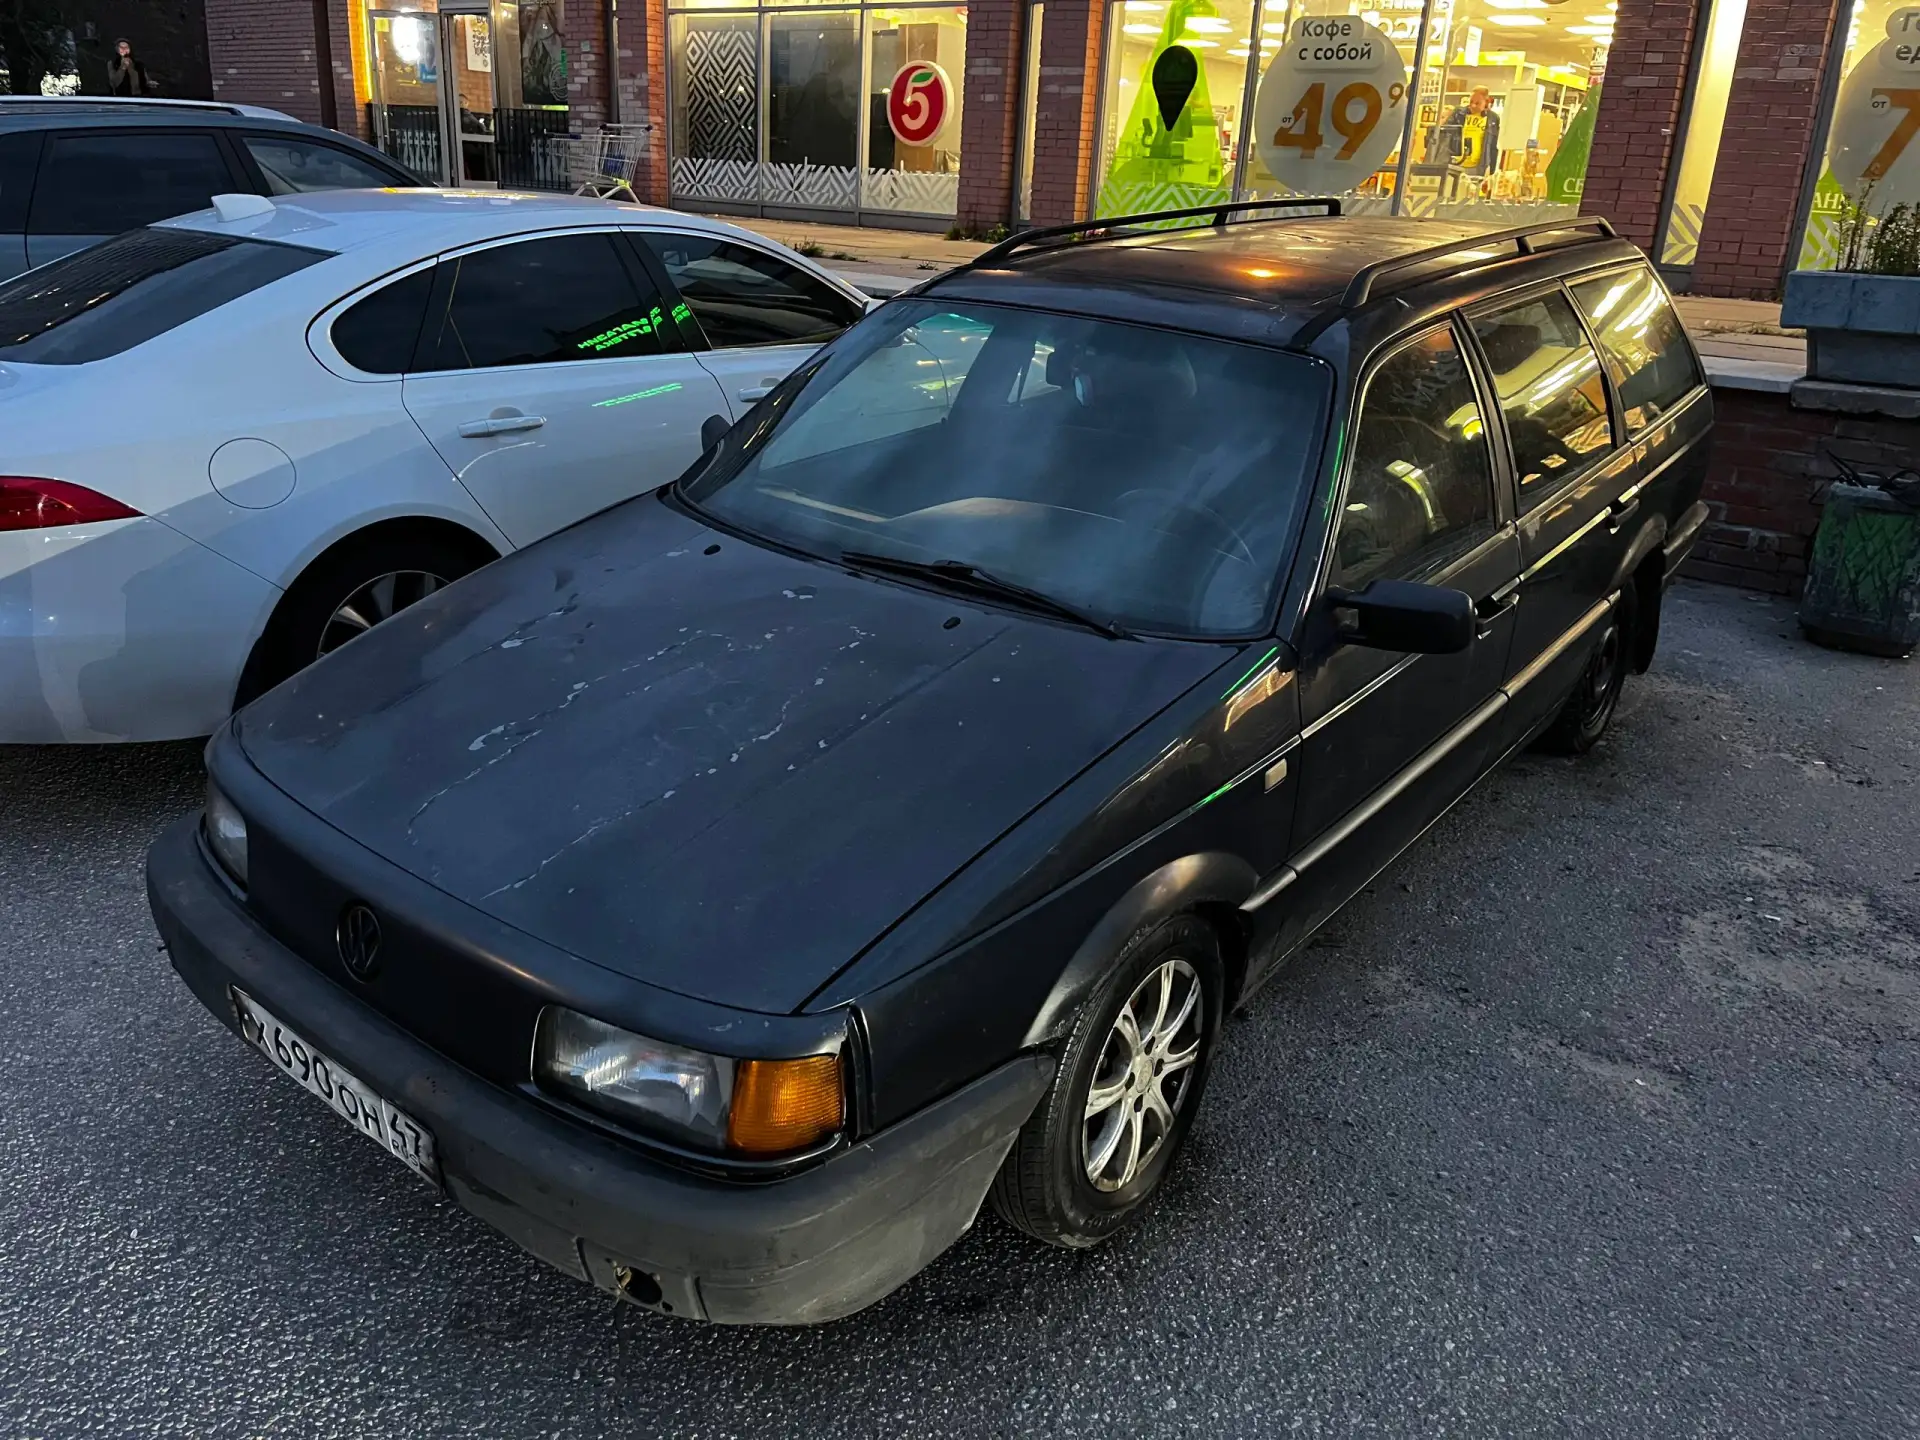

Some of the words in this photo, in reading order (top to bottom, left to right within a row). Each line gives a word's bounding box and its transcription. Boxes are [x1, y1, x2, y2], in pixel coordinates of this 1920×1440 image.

[1301, 20, 1352, 41] Кофе
[1902, 12, 1920, 32] Г
[1298, 47, 1308, 60] с
[1313, 43, 1372, 60] собой
[901, 70, 935, 130] 5
[1871, 99, 1887, 108] от
